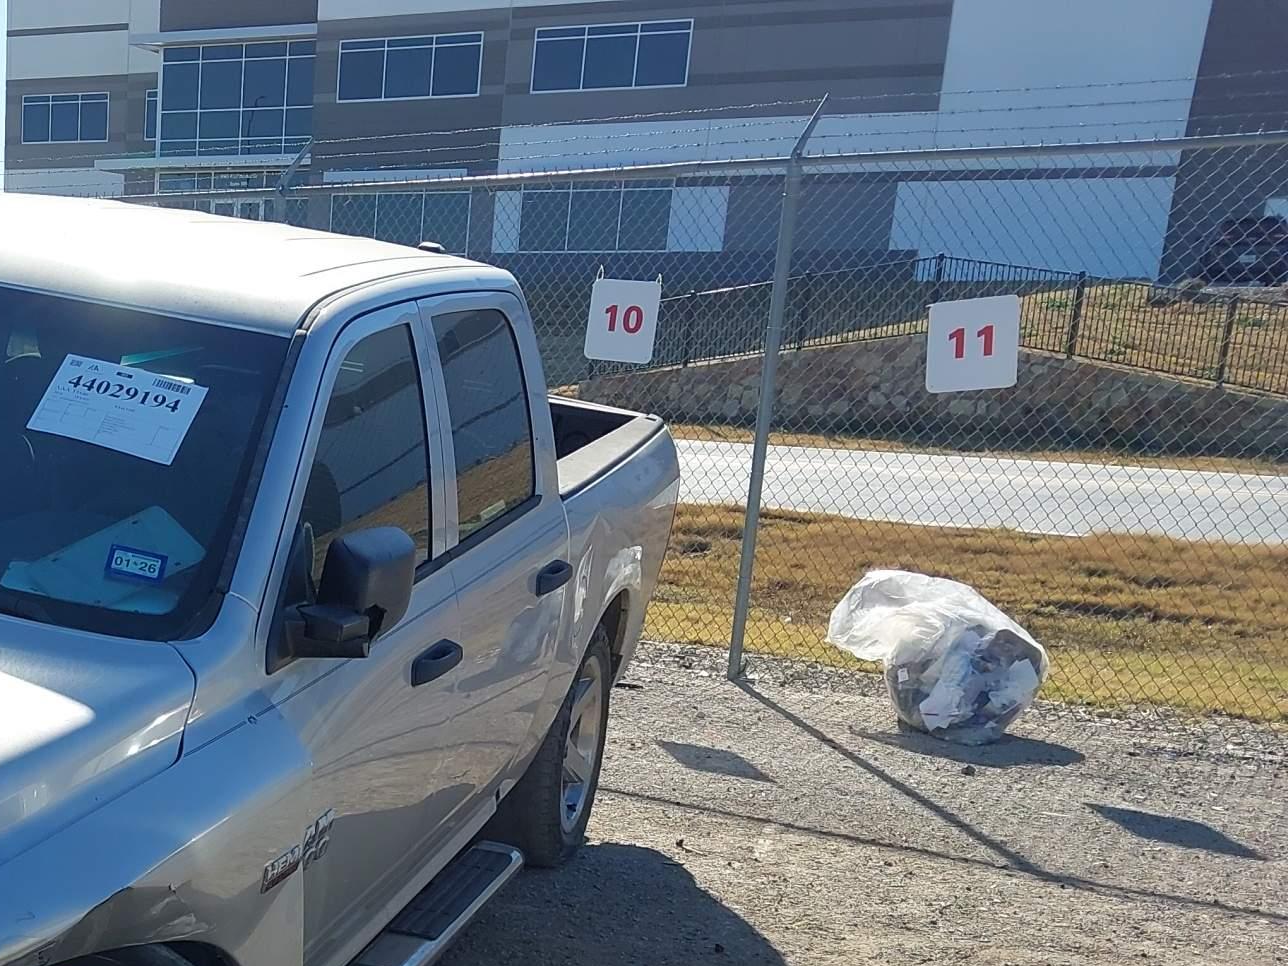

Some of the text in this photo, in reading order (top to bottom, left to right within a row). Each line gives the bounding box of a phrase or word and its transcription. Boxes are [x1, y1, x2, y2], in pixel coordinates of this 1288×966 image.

[604, 303, 644, 334] 10
[948, 324, 995, 359] 11
[68, 374, 182, 413] 44029194
[114, 555, 131, 568] 01
[138, 561, 157, 574] 26
[265, 844, 303, 884] HEMI
